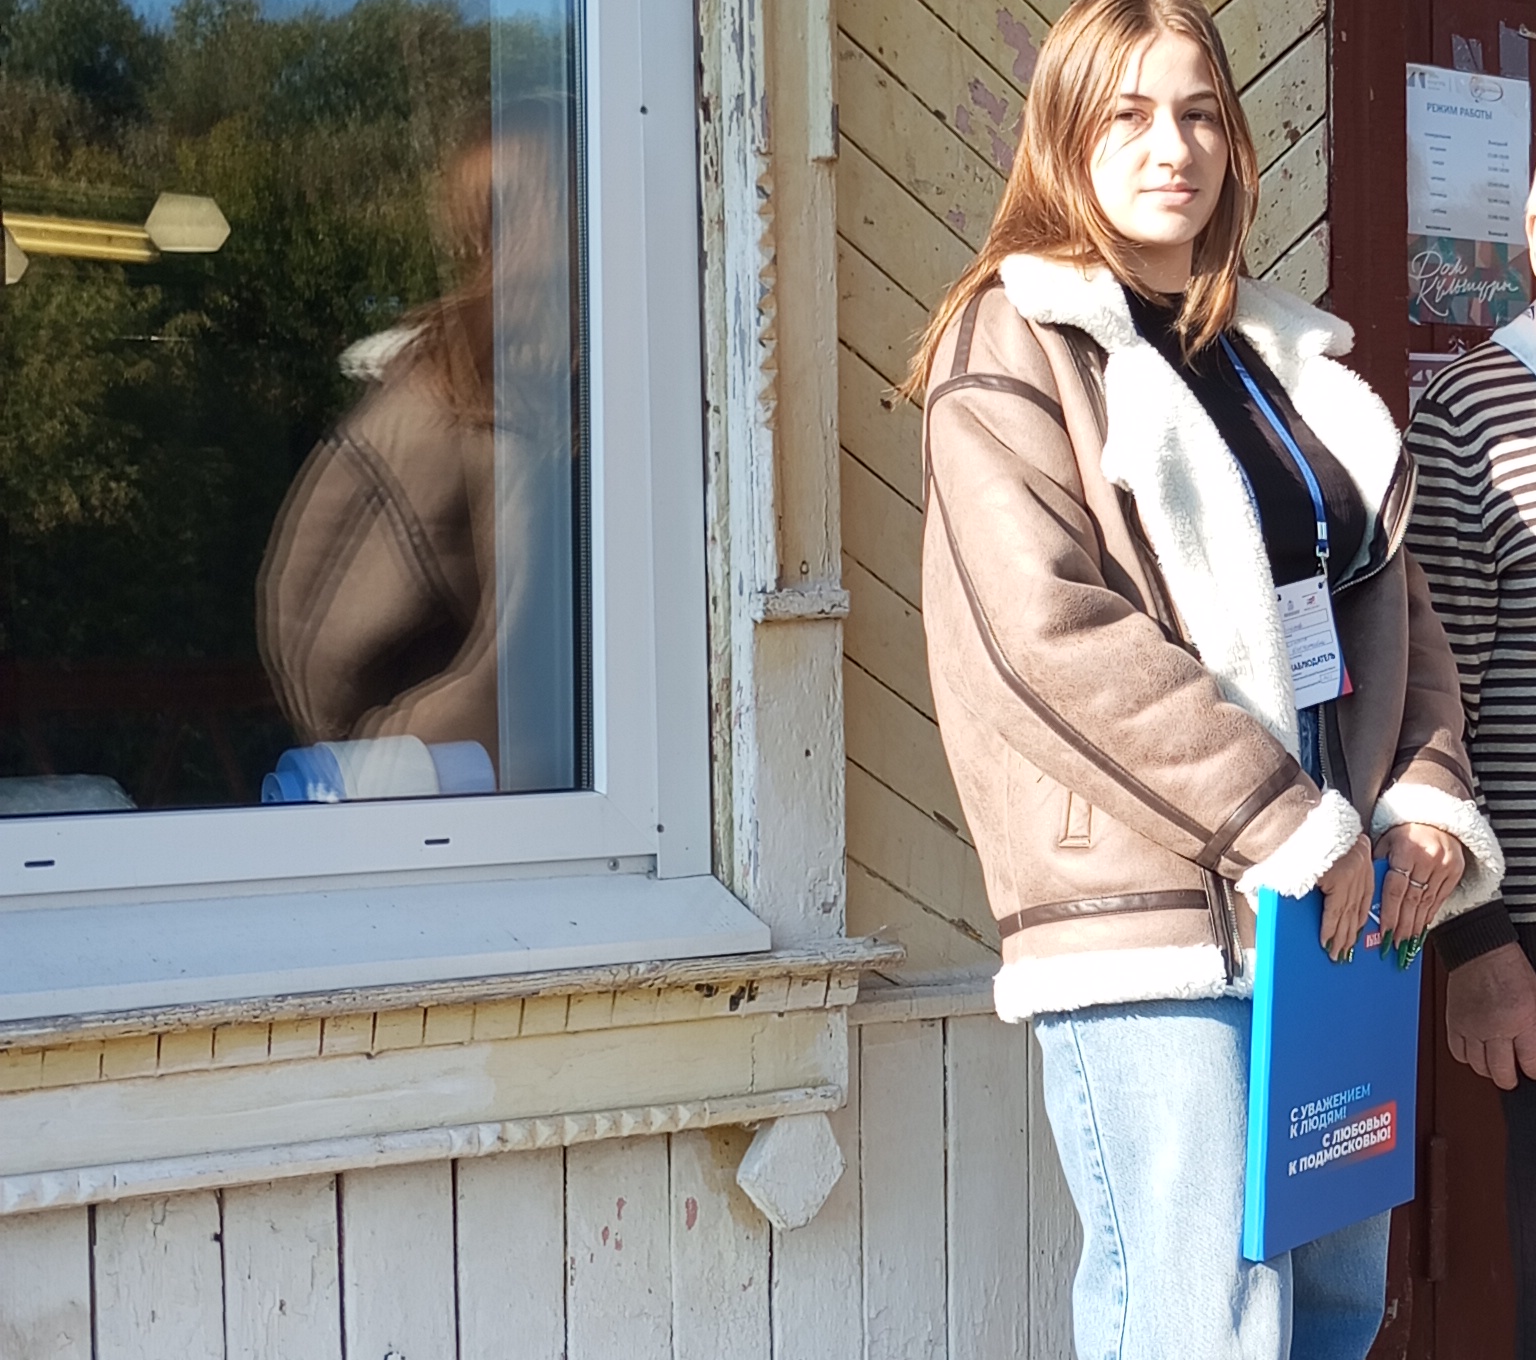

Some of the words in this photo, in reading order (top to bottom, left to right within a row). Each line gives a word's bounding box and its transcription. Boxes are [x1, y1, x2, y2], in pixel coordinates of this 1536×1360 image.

[1426, 102, 1458, 116] РЕЖИМ
[1460, 107, 1493, 120] РАБОТЫ
[1408, 250, 1467, 281] Дом
[1290, 1107, 1299, 1123] С
[1299, 1083, 1371, 1120] УВАЖЕНИЕМ
[1289, 1123, 1299, 1139] К
[1300, 1106, 1347, 1136] ЛЮДЯМ!
[1322, 1133, 1331, 1148] С
[1332, 1111, 1391, 1145] ЛЮБОВЬЮ
[1288, 1160, 1297, 1177] К
[1299, 1126, 1392, 1172] ПОДМОСКОВЬЮ!
